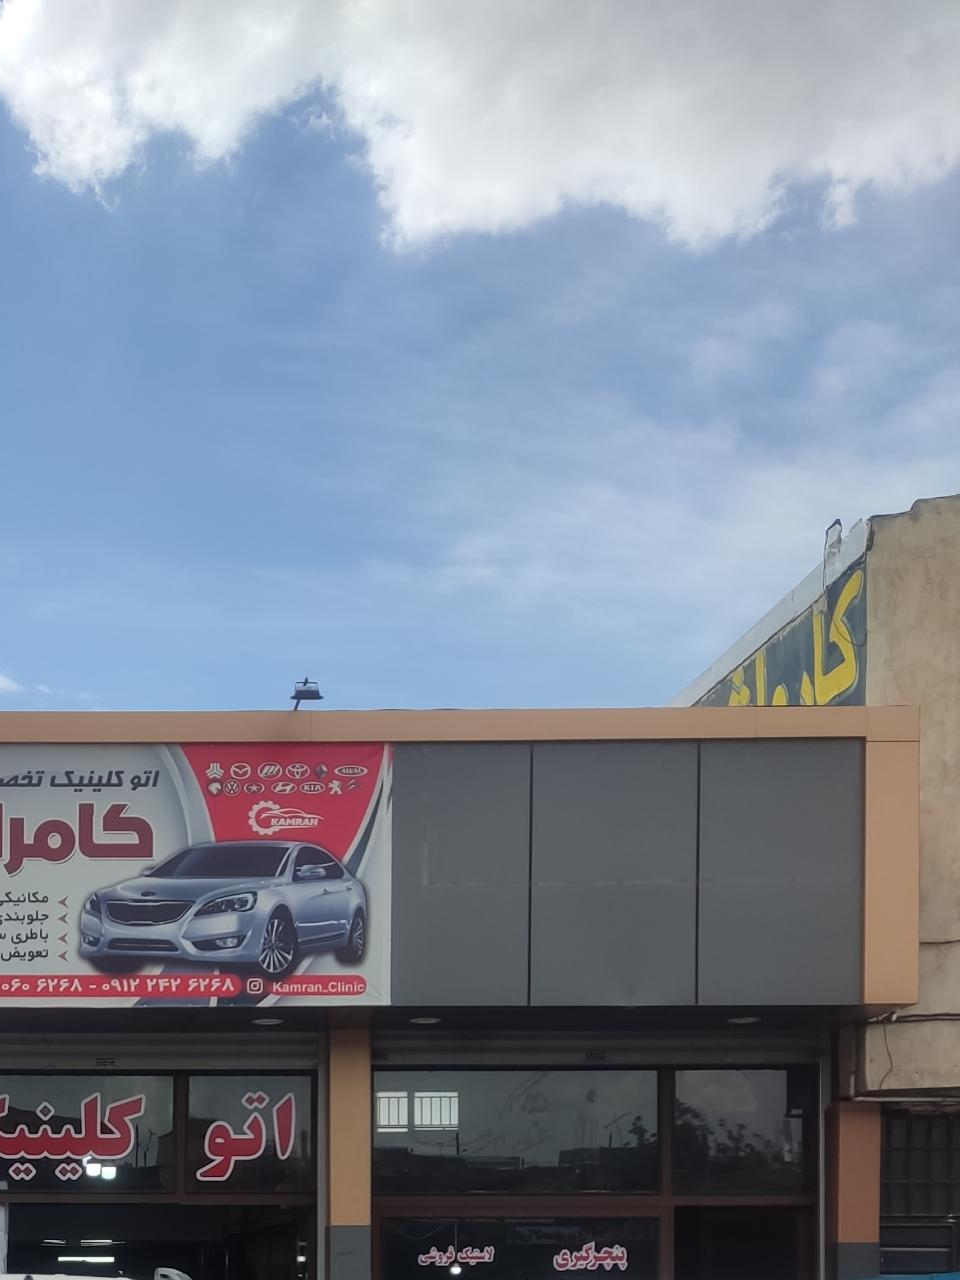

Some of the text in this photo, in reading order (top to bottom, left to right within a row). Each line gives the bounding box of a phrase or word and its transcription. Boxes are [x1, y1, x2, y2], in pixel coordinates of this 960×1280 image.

[50, 770, 125, 792] کلینیک
[130, 770, 160, 791] اتو
[270, 817, 319, 827] KAMRAN
[10, 928, 49, 944] باطری
[0, 946, 49, 962] تعویض
[1, 978, 30, 992] ۰۶۰
[36, 978, 83, 992] ۶۲۶۸
[102, 978, 140, 992] ۰۹۱۲
[146, 978, 180, 992] ۲۴۲
[188, 978, 235, 992] ۶۲۶۸
[272, 981, 365, 993] Kamran_Clinic
[195, 1090, 296, 1182] اتو
[418, 1245, 495, 1266] لاستیک فروشی
[553, 1241, 628, 1271] پنچرگیری
